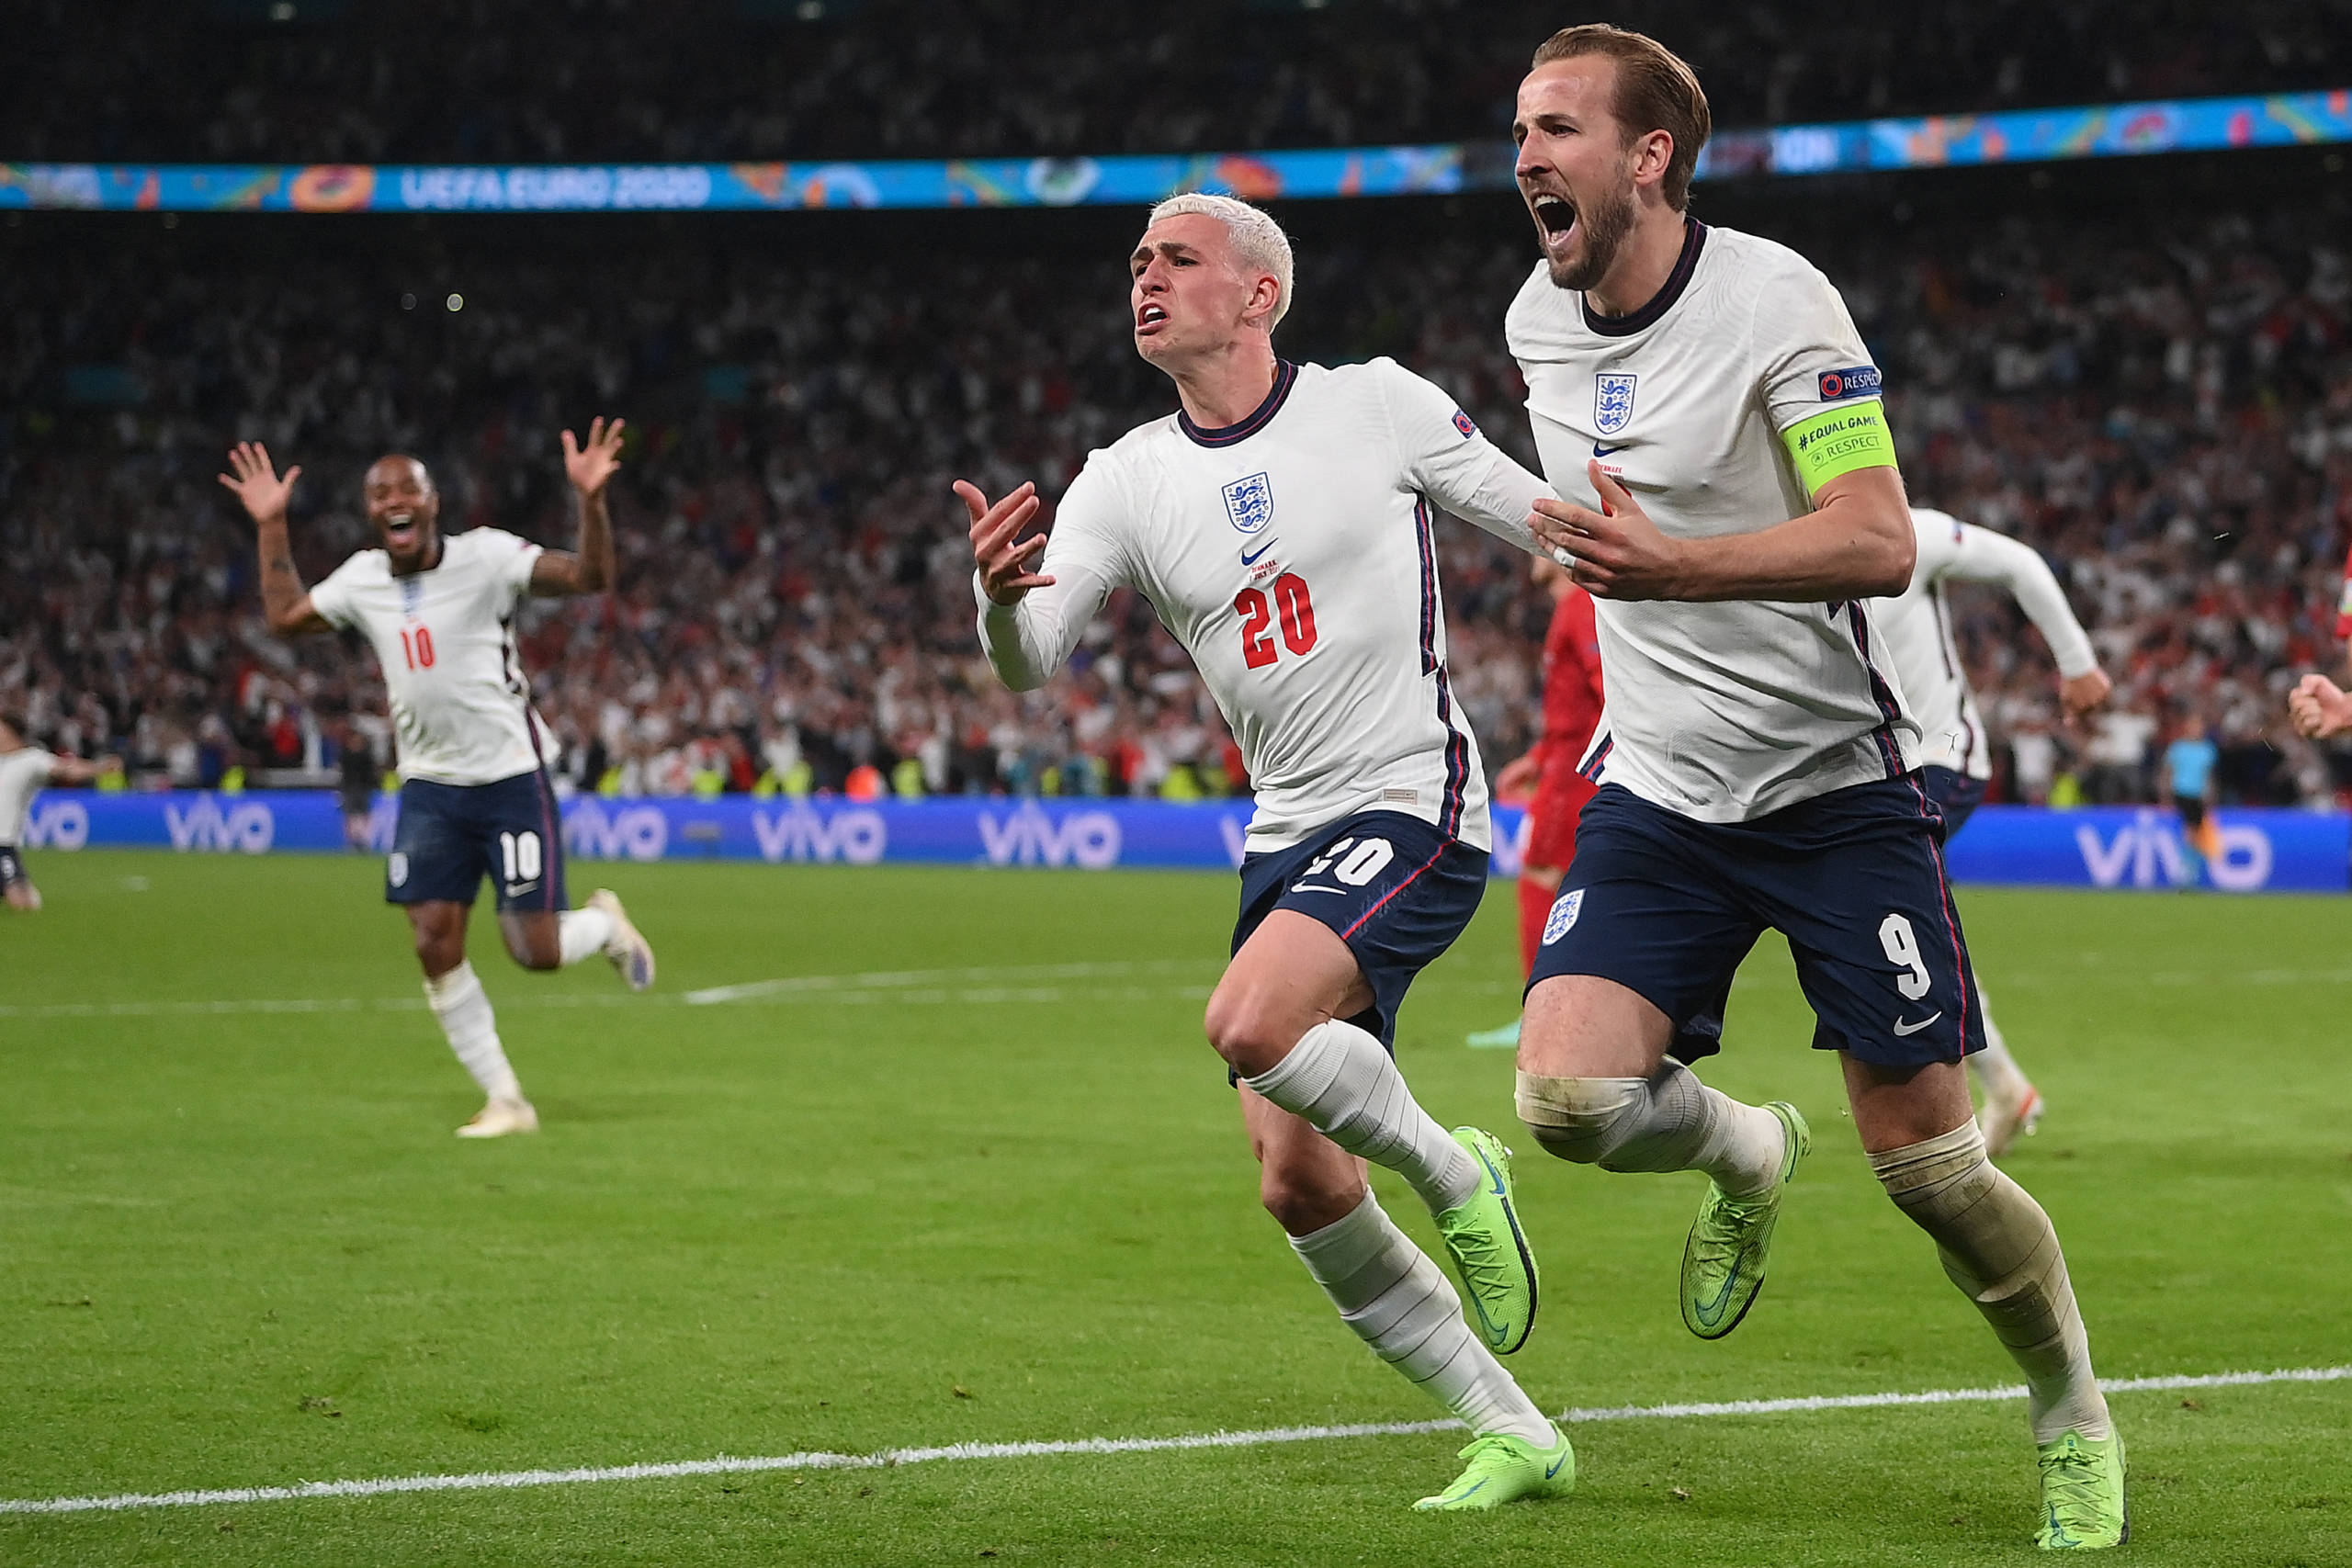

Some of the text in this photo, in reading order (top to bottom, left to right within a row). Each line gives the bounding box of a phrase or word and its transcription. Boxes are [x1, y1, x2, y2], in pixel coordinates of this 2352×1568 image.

[401, 165, 712, 209] UEFA EURO 2020
[1844, 372, 1880, 390] RESPEC
[1826, 435, 1880, 457] RESPECT
[1233, 571, 1317, 670] 20
[400, 627, 435, 671] 10
[499, 830, 541, 881] 10
[752, 799, 888, 864] vivo
[978, 796, 1122, 870] vivo
[1878, 913, 1931, 1000] 9
